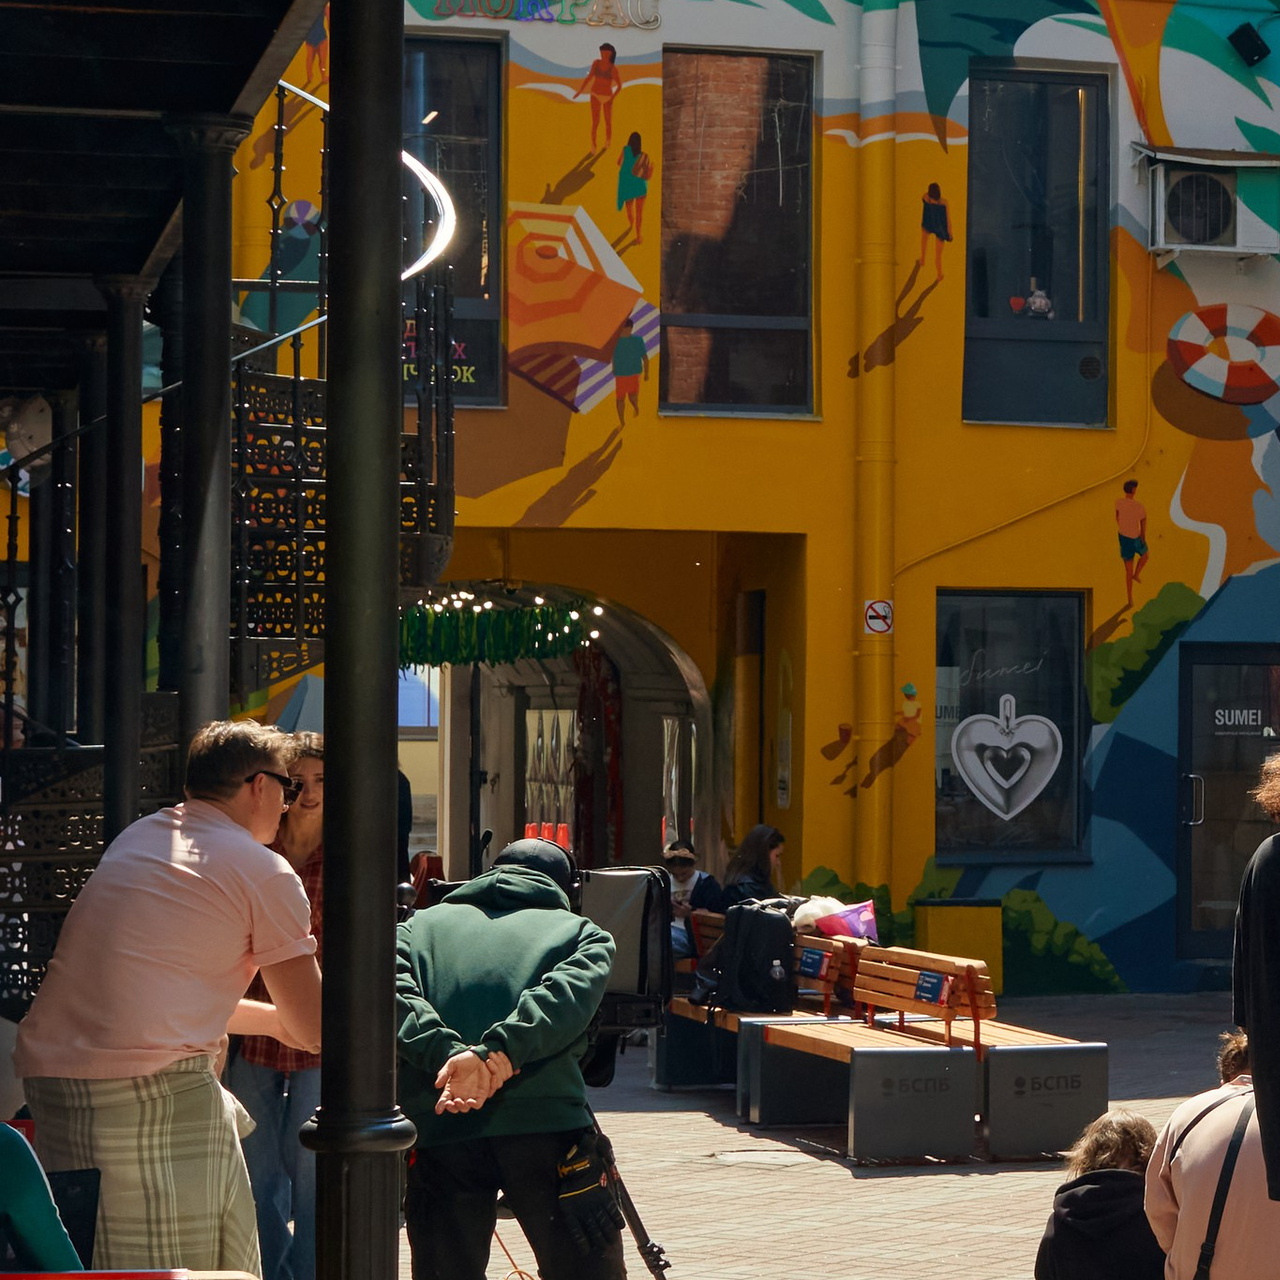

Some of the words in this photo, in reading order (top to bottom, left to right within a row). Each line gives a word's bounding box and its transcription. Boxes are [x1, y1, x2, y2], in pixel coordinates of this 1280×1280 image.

[1215, 709, 1261, 726] SUMEI
[899, 1078, 950, 1093] БСПБ
[1031, 1074, 1081, 1091] БСПБ
